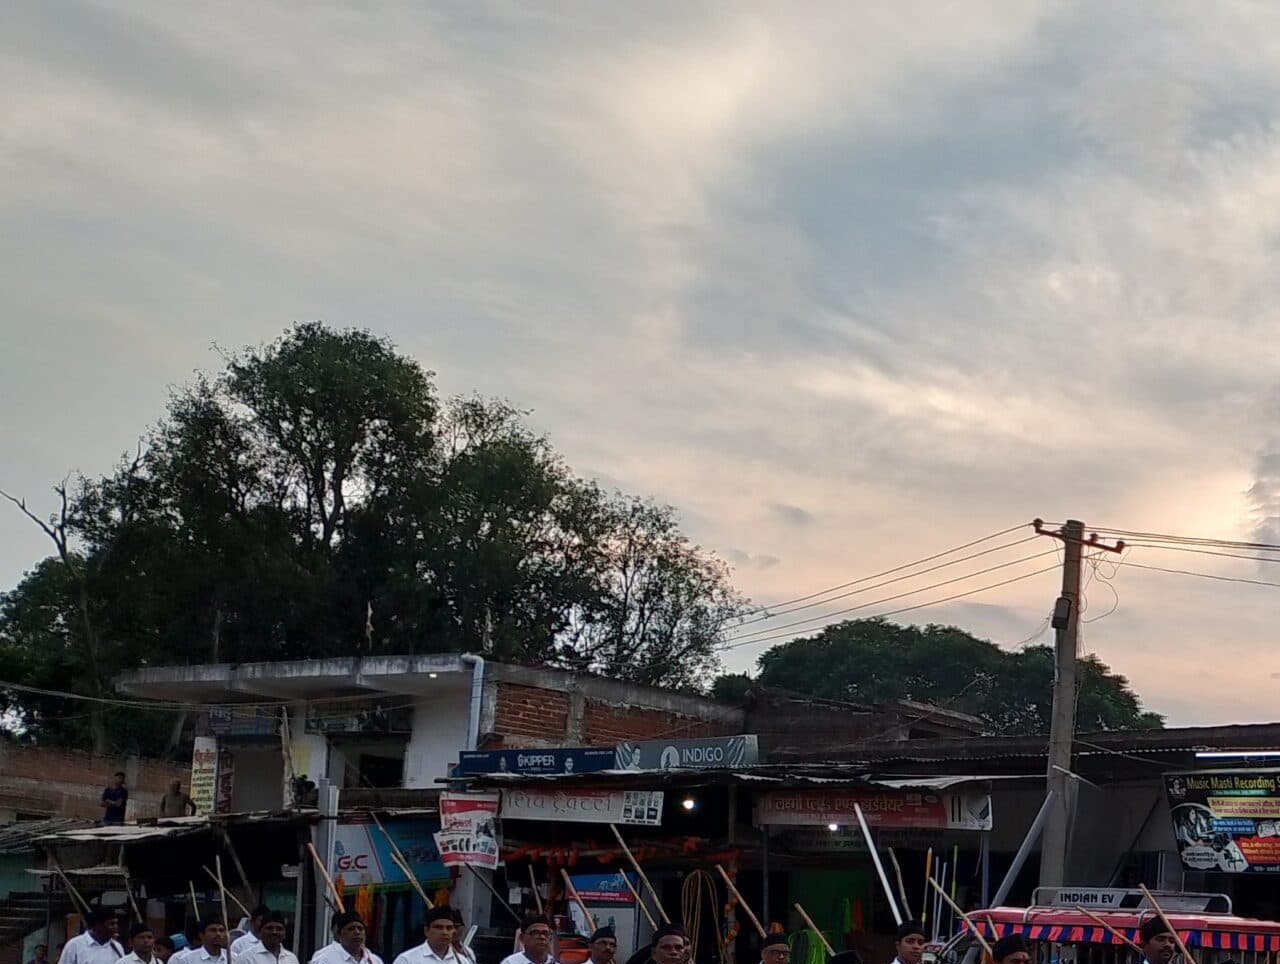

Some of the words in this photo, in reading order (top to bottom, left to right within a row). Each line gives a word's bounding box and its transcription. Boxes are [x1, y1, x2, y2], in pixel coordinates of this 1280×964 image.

[682, 747, 723, 762] INDIGO
[1186, 777, 1210, 789] Music
[1210, 776, 1233, 789] Masti
[1234, 775, 1275, 791] Recording
[1060, 893, 1098, 904] INDIAN
[1102, 895, 1115, 904] EV
